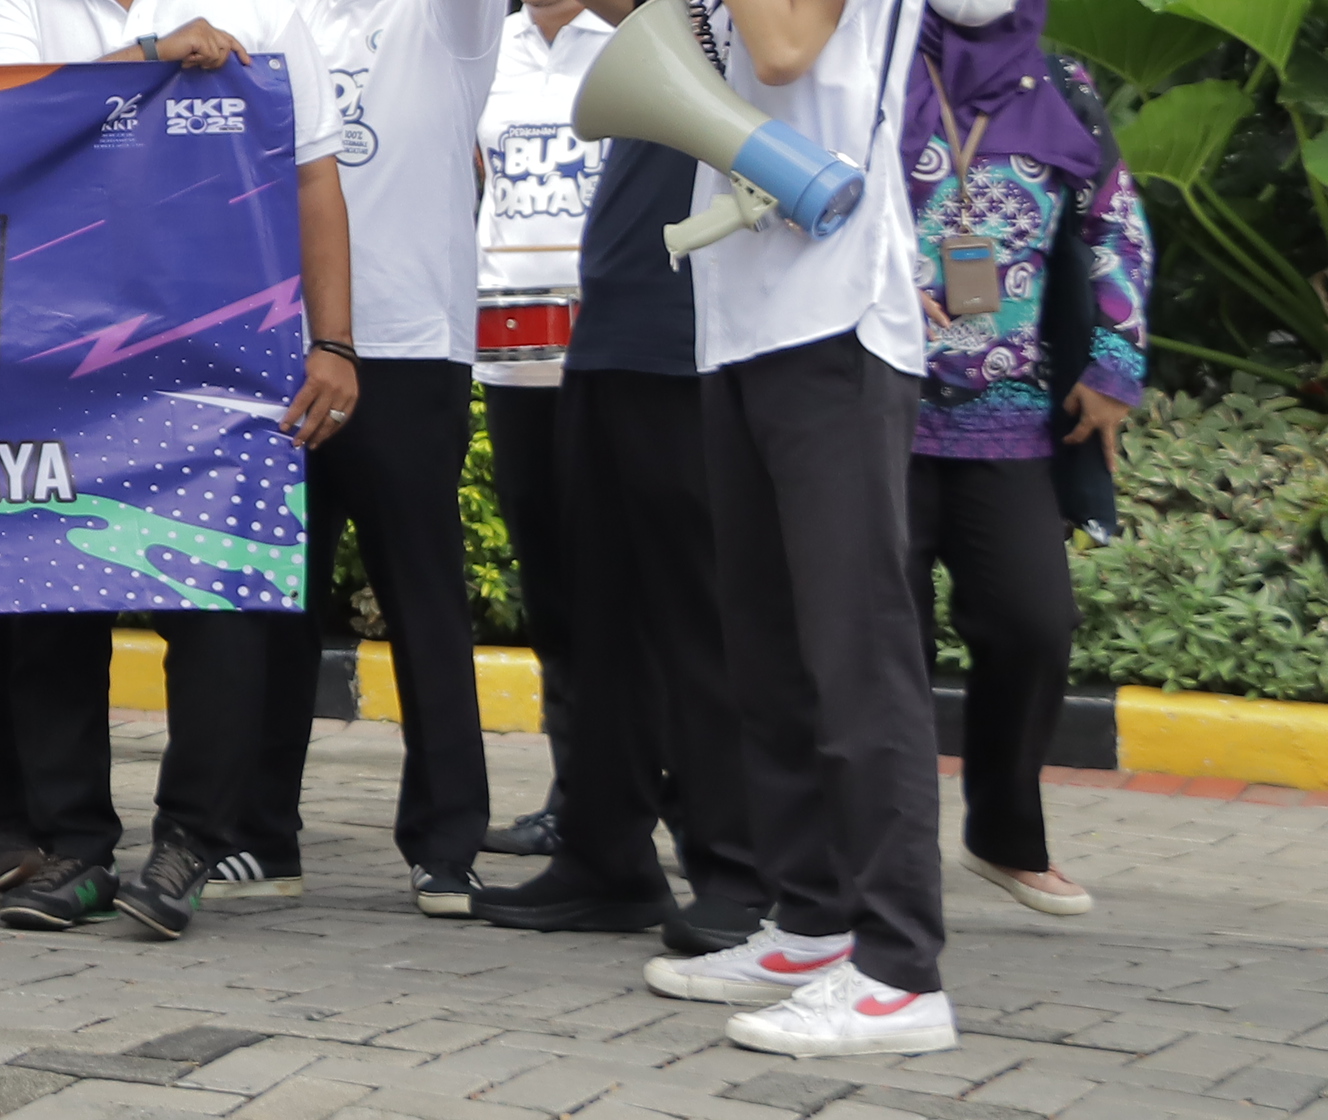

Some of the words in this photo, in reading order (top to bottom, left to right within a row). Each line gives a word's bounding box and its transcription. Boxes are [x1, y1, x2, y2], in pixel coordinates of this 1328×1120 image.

[166, 98, 246, 117] KKP
[166, 117, 244, 134] 2025
[494, 174, 583, 216] DAYA
